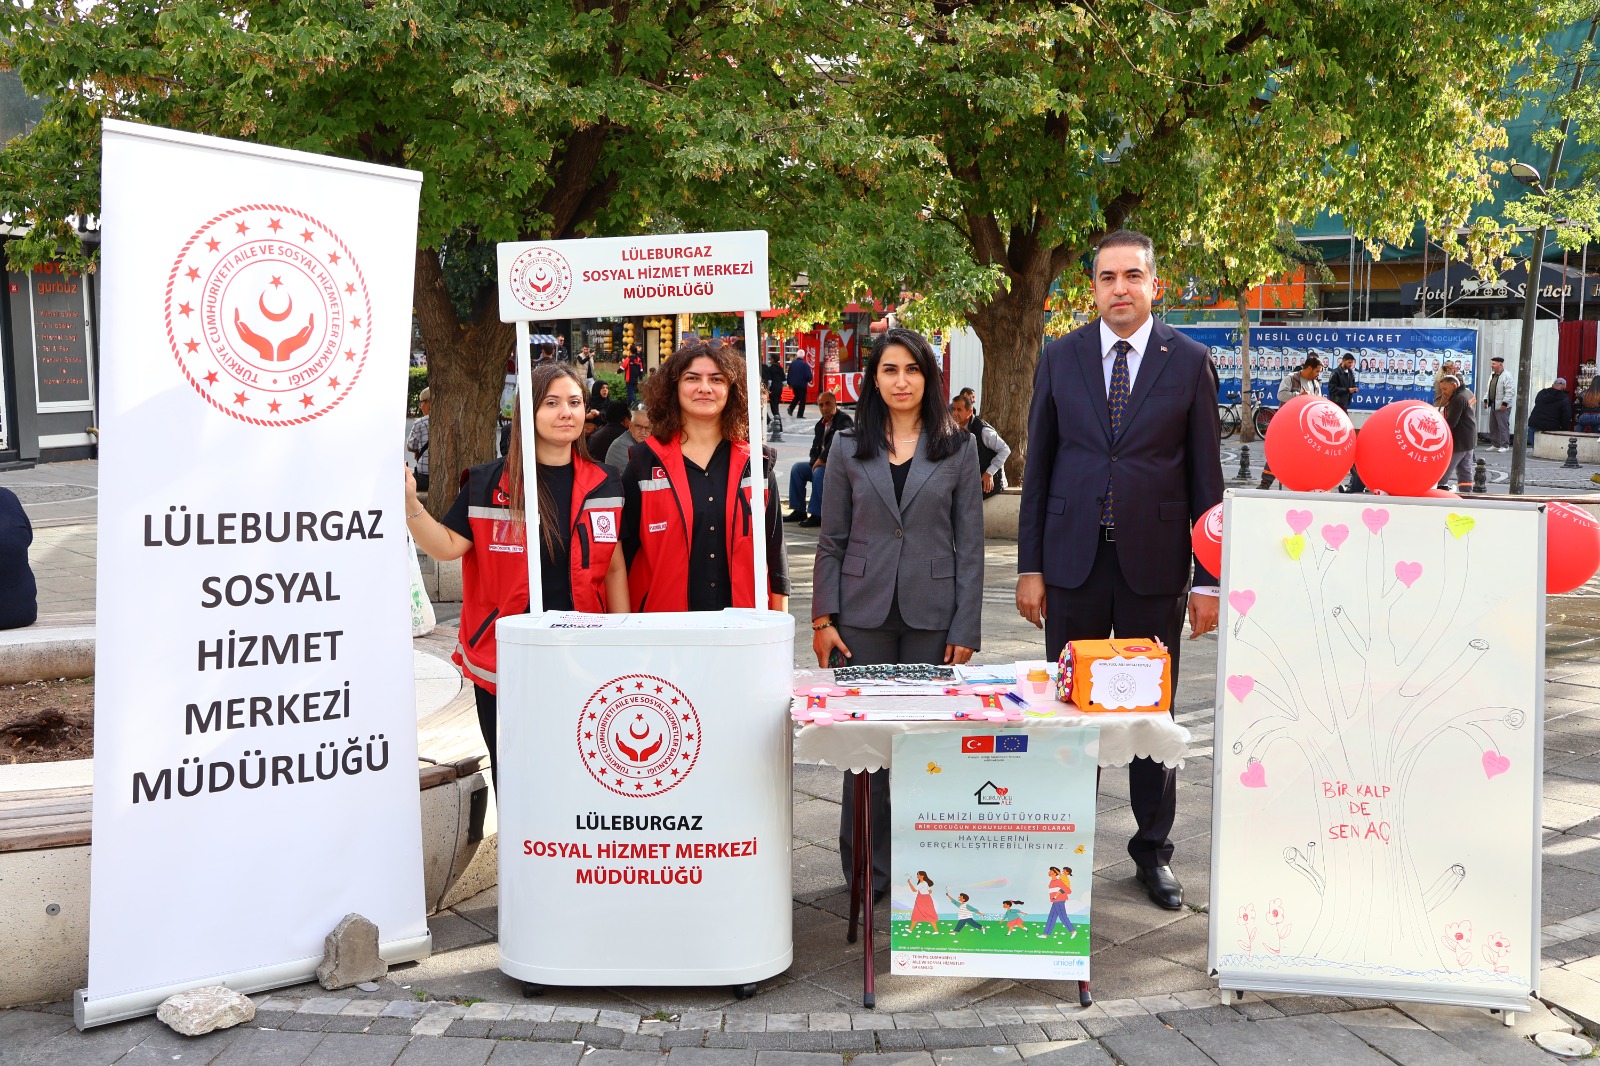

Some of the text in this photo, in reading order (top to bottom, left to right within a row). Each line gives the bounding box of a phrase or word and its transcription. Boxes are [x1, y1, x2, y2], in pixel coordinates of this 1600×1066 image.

[622, 245, 712, 261] LÜLEBURGAZ
[583, 260, 754, 282] SOSYAL HİZMET MERKEZİ
[623, 282, 714, 299] MÜDÜRLÜĞÜ
[1414, 283, 1572, 300] Hotel Srücü
[206, 244, 341, 386] TÜRKİYE CUMHURİYETİ AİLE VE SOSYAL HİZMETLER BAKANLIĞI
[1257, 332, 1290, 341] NESİL
[1297, 332, 1338, 343] GÜÇLÜ
[1346, 332, 1402, 342] TİCARET
[1303, 434, 1321, 452] 2025
[1324, 448, 1342, 456] AİLE
[1394, 429, 1447, 463] 2025 AİLE YILI
[143, 505, 384, 547] LÜLEBURGAZ
[1573, 517, 1590, 527] YILI
[201, 571, 340, 608] SOSYAL
[198, 629, 343, 671] HİZMET
[185, 681, 350, 735] MERKEZİ
[615, 698, 629, 710] AİLE
[640, 696, 665, 712] SOSYAL
[664, 709, 680, 747] HİZMETLER
[132, 734, 390, 803] MÜDÜRLÜĞÜ
[1323, 781, 1391, 798] BİR KALP
[918, 811, 1072, 821] AİLEMİZİ BÜYÜTÜYORUZ!
[1349, 801, 1371, 816] DE
[576, 812, 703, 831] LÜLEBURGAZ
[958, 834, 1029, 842] HAYALLERİNİ
[1329, 821, 1391, 844] SEN AÇ
[523, 837, 757, 858] SOSYAL HİZMET MERKEZİ
[576, 865, 703, 884] MÜDÜRLÜĞÜ
[1053, 958, 1075, 967] unicef
